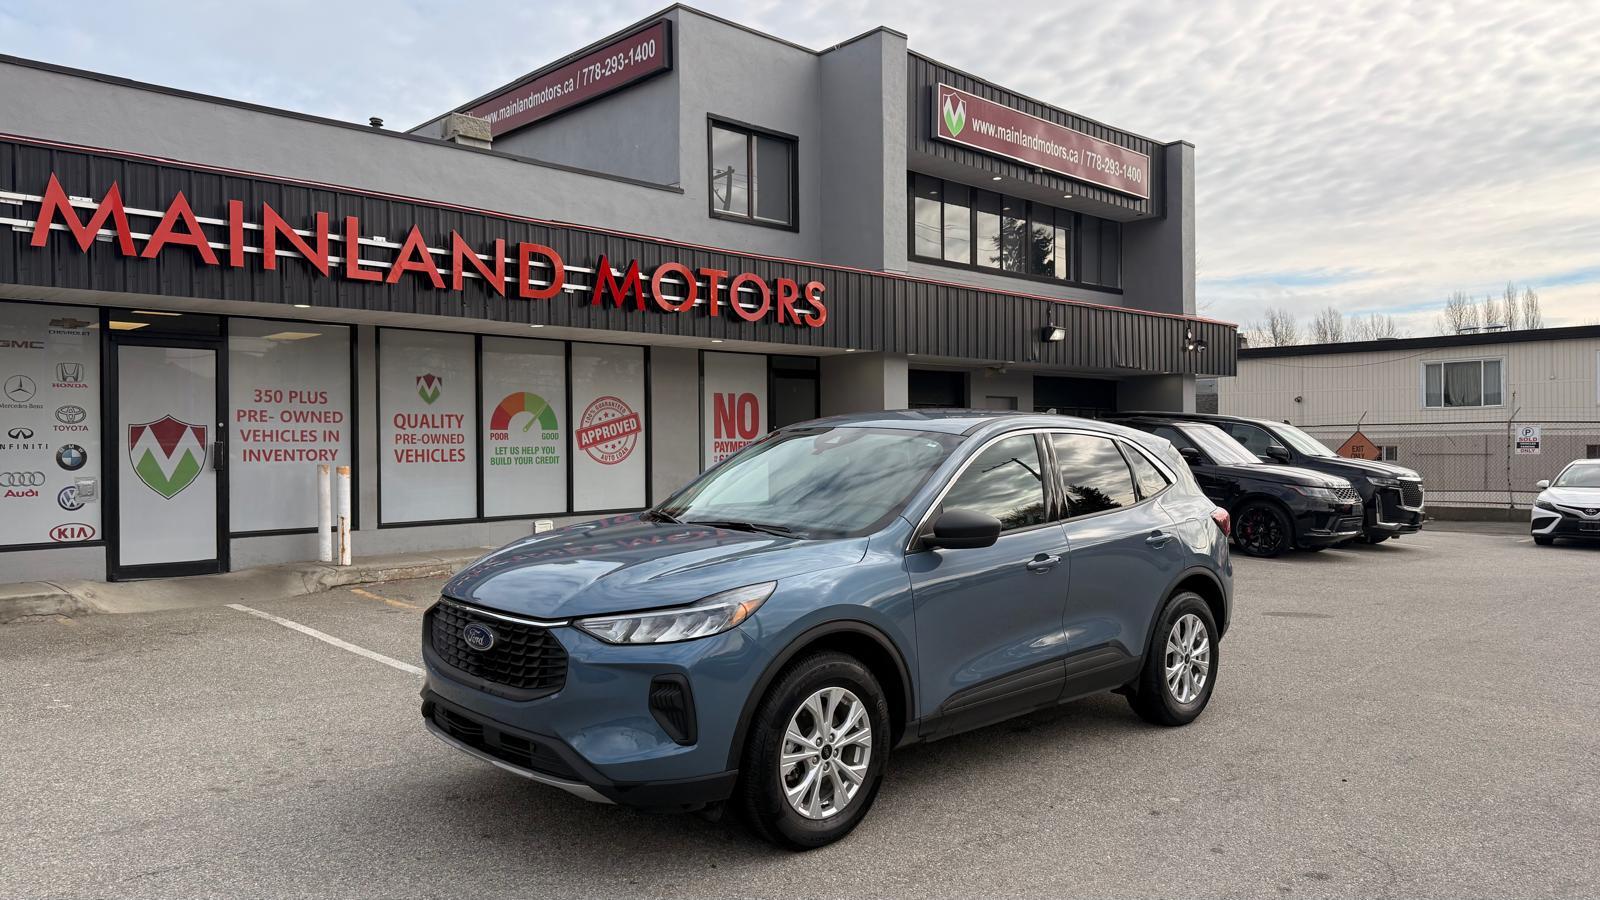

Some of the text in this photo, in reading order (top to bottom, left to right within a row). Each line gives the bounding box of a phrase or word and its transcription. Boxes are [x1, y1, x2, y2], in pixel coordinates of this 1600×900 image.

[482, 39, 656, 124] ww.mainlandmotors.ca / 778-293-1400
[972, 116, 1142, 184] www.mainlandmotors.ca / 778-293-1400
[30, 171, 828, 328] MAINLAND MOTORS
[254, 389, 328, 404] 350 PLUS
[236, 409, 344, 423] PRE- OWNED
[393, 413, 465, 429] QUALITY
[713, 392, 760, 440] NO
[240, 429, 340, 442] VEHICLES IN
[490, 432, 509, 440] POOR
[541, 432, 559, 440] GOOD
[581, 418, 637, 446] APPROVED
[395, 433, 465, 445] PRE-OWNED
[495, 446, 555, 455] LET US HELP YOU
[714, 440, 752, 452] PAYME
[1351, 445, 1365, 453] EXIT
[243, 449, 339, 462] INVENTORY
[394, 448, 466, 463] VEHICLES
[616, 447, 629, 459] LOAN
[490, 456, 560, 466] BUILD YOUR CREDIT
[4, 489, 39, 498] Audi
[57, 527, 88, 539] KIA
[467, 628, 486, 646] Ford
